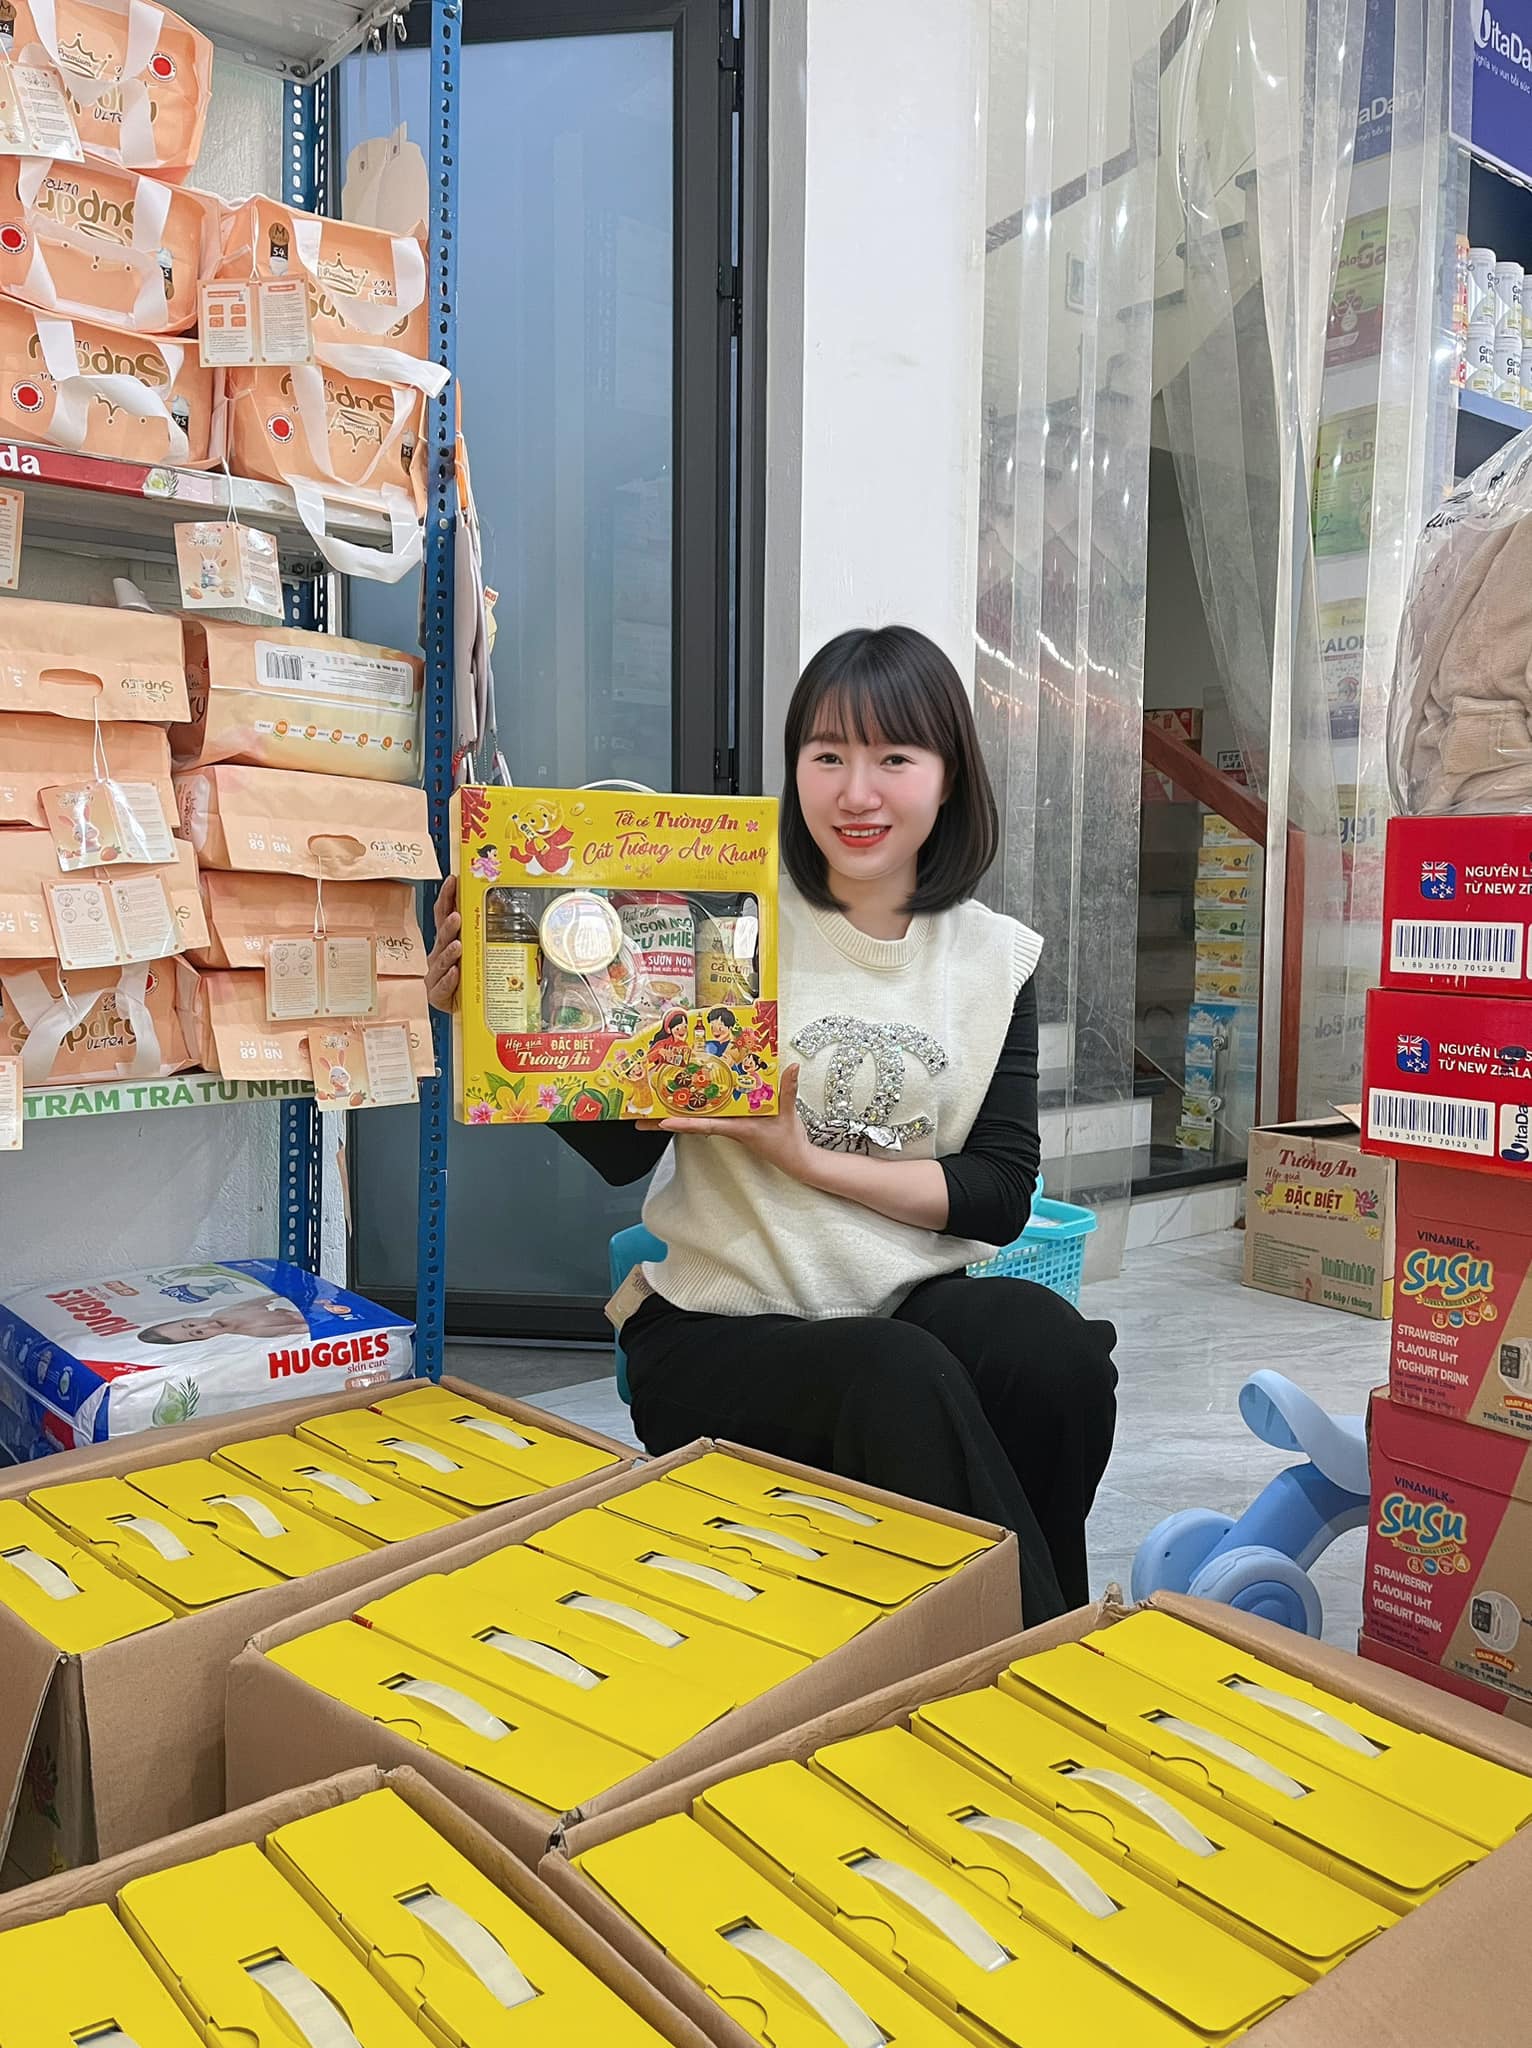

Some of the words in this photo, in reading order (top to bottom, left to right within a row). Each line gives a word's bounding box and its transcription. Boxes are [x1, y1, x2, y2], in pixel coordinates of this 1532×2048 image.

[272, 247, 285, 258] 54
[615, 810, 635, 828] Tết
[582, 842, 614, 865] Cát
[615, 832, 672, 864] Tường
[678, 837, 714, 861] An
[717, 843, 769, 866] Khang
[1465, 863, 1519, 878] NGUYÊN
[1464, 880, 1482, 894] TỪ
[1485, 883, 1516, 895] NEW
[86, 1035, 124, 1050] ULTRA
[551, 1036, 571, 1055] ĐẶC
[1438, 1042, 1492, 1059] NGUYÊN
[1438, 1056, 1455, 1071] TỪ
[1458, 1062, 1487, 1075] NEW
[126, 1077, 194, 1109] TRÀ
[1284, 1185, 1313, 1210] ĐẶC
[1313, 1188, 1344, 1214] BIỆT
[1417, 1230, 1476, 1250] VINAMILK
[1397, 1323, 1460, 1348] STRAWBERRY
[267, 1332, 391, 1380] HUGGIES
[1396, 1340, 1438, 1361] FLAVOUR
[1439, 1350, 1460, 1366] UHT
[347, 1362, 368, 1375] skin
[1396, 1357, 1439, 1380] YOGHURT
[1440, 1367, 1470, 1387] DRINK
[1395, 1476, 1449, 1503] VINAMILK
[1373, 1563, 1433, 1594] STRAWBERRY
[1372, 1579, 1413, 1605] FLAVOUR
[1413, 1594, 1433, 1611] UHT
[1372, 1595, 1415, 1623] YOGHURT
[1414, 1612, 1443, 1634] DRINK
